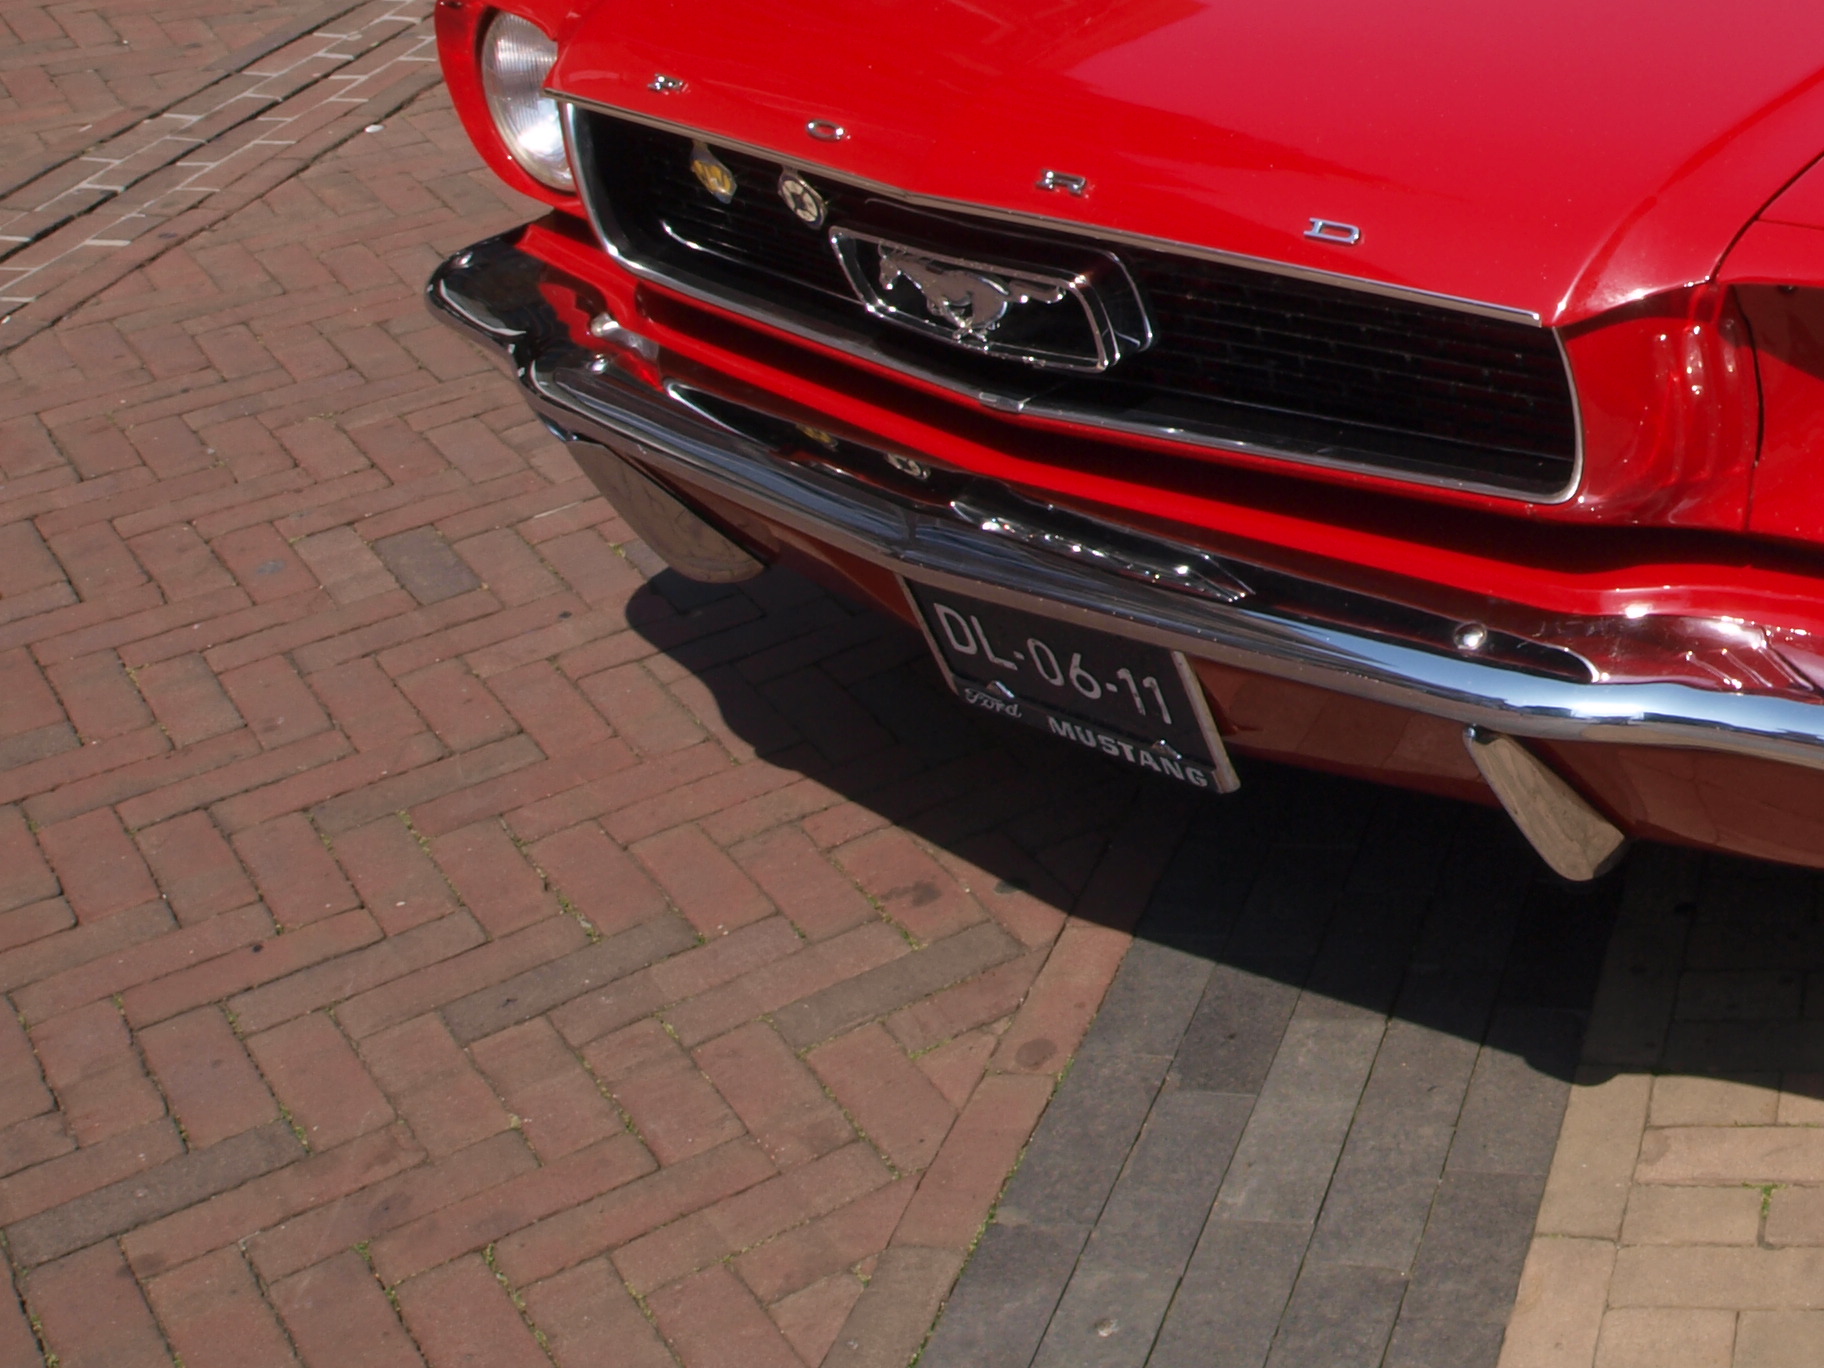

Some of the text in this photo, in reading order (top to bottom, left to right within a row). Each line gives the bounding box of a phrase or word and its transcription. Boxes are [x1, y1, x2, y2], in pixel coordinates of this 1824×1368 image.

[933, 602, 1172, 725] DL-06-11
[963, 687, 1208, 788] Ford MUSTANG
